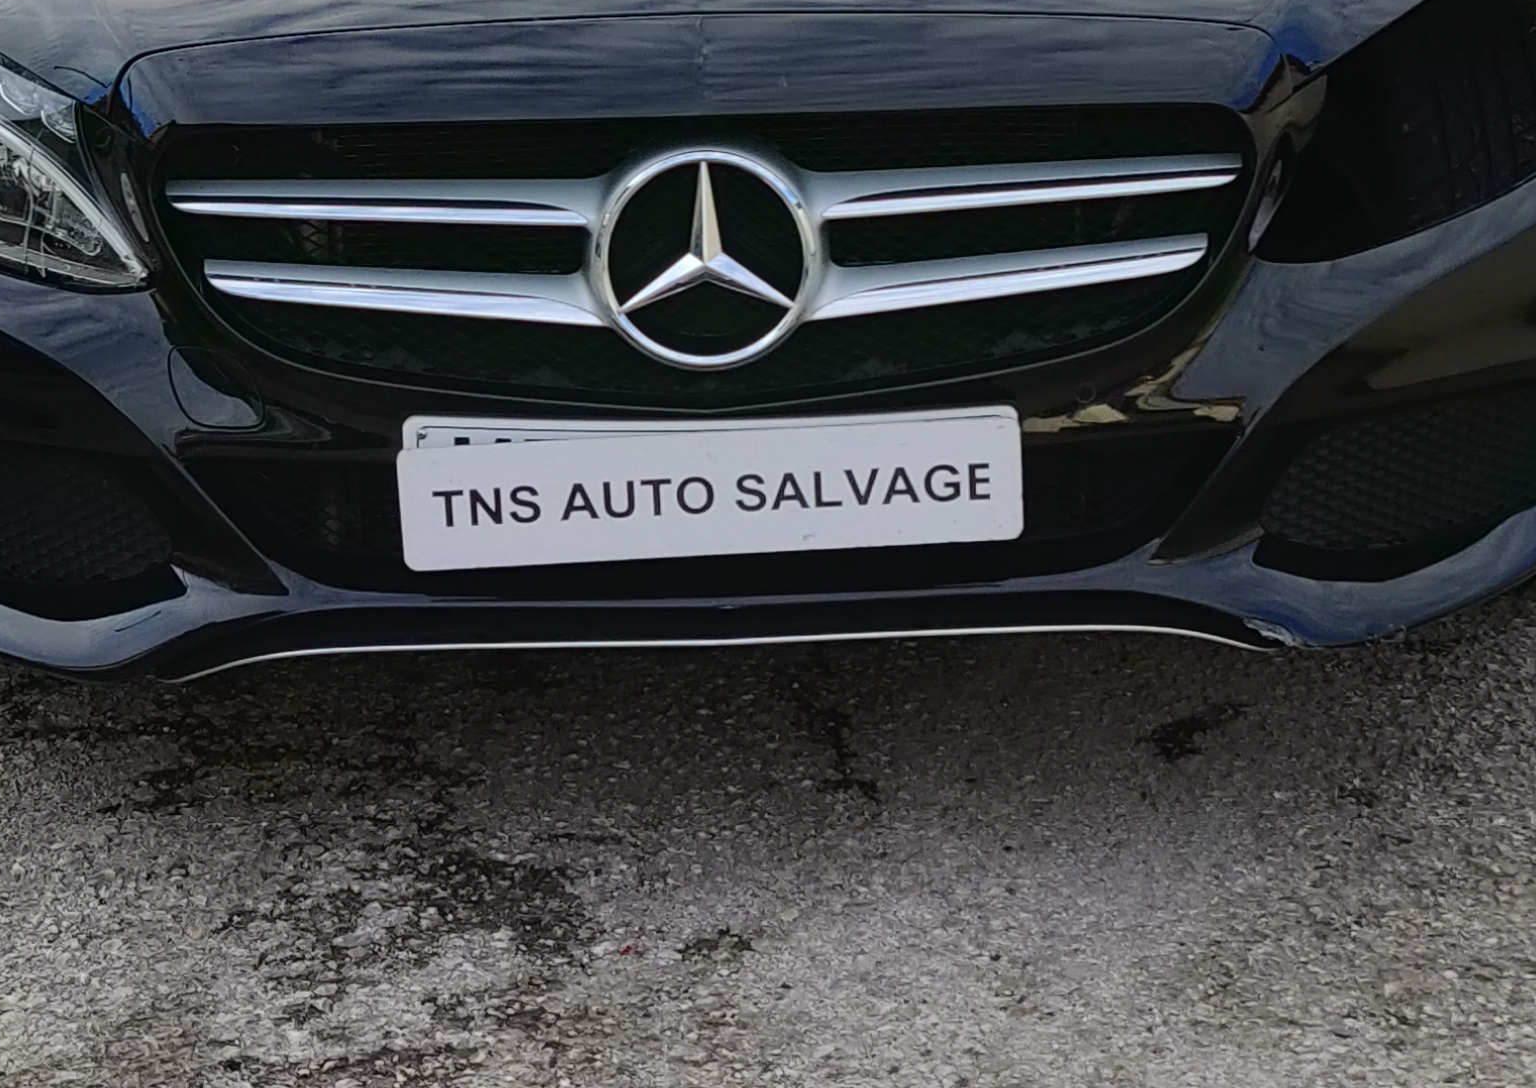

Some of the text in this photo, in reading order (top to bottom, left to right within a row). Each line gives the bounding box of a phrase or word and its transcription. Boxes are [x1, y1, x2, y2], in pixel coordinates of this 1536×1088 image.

[432, 463, 991, 527] TNS AUTO SALVAGE
